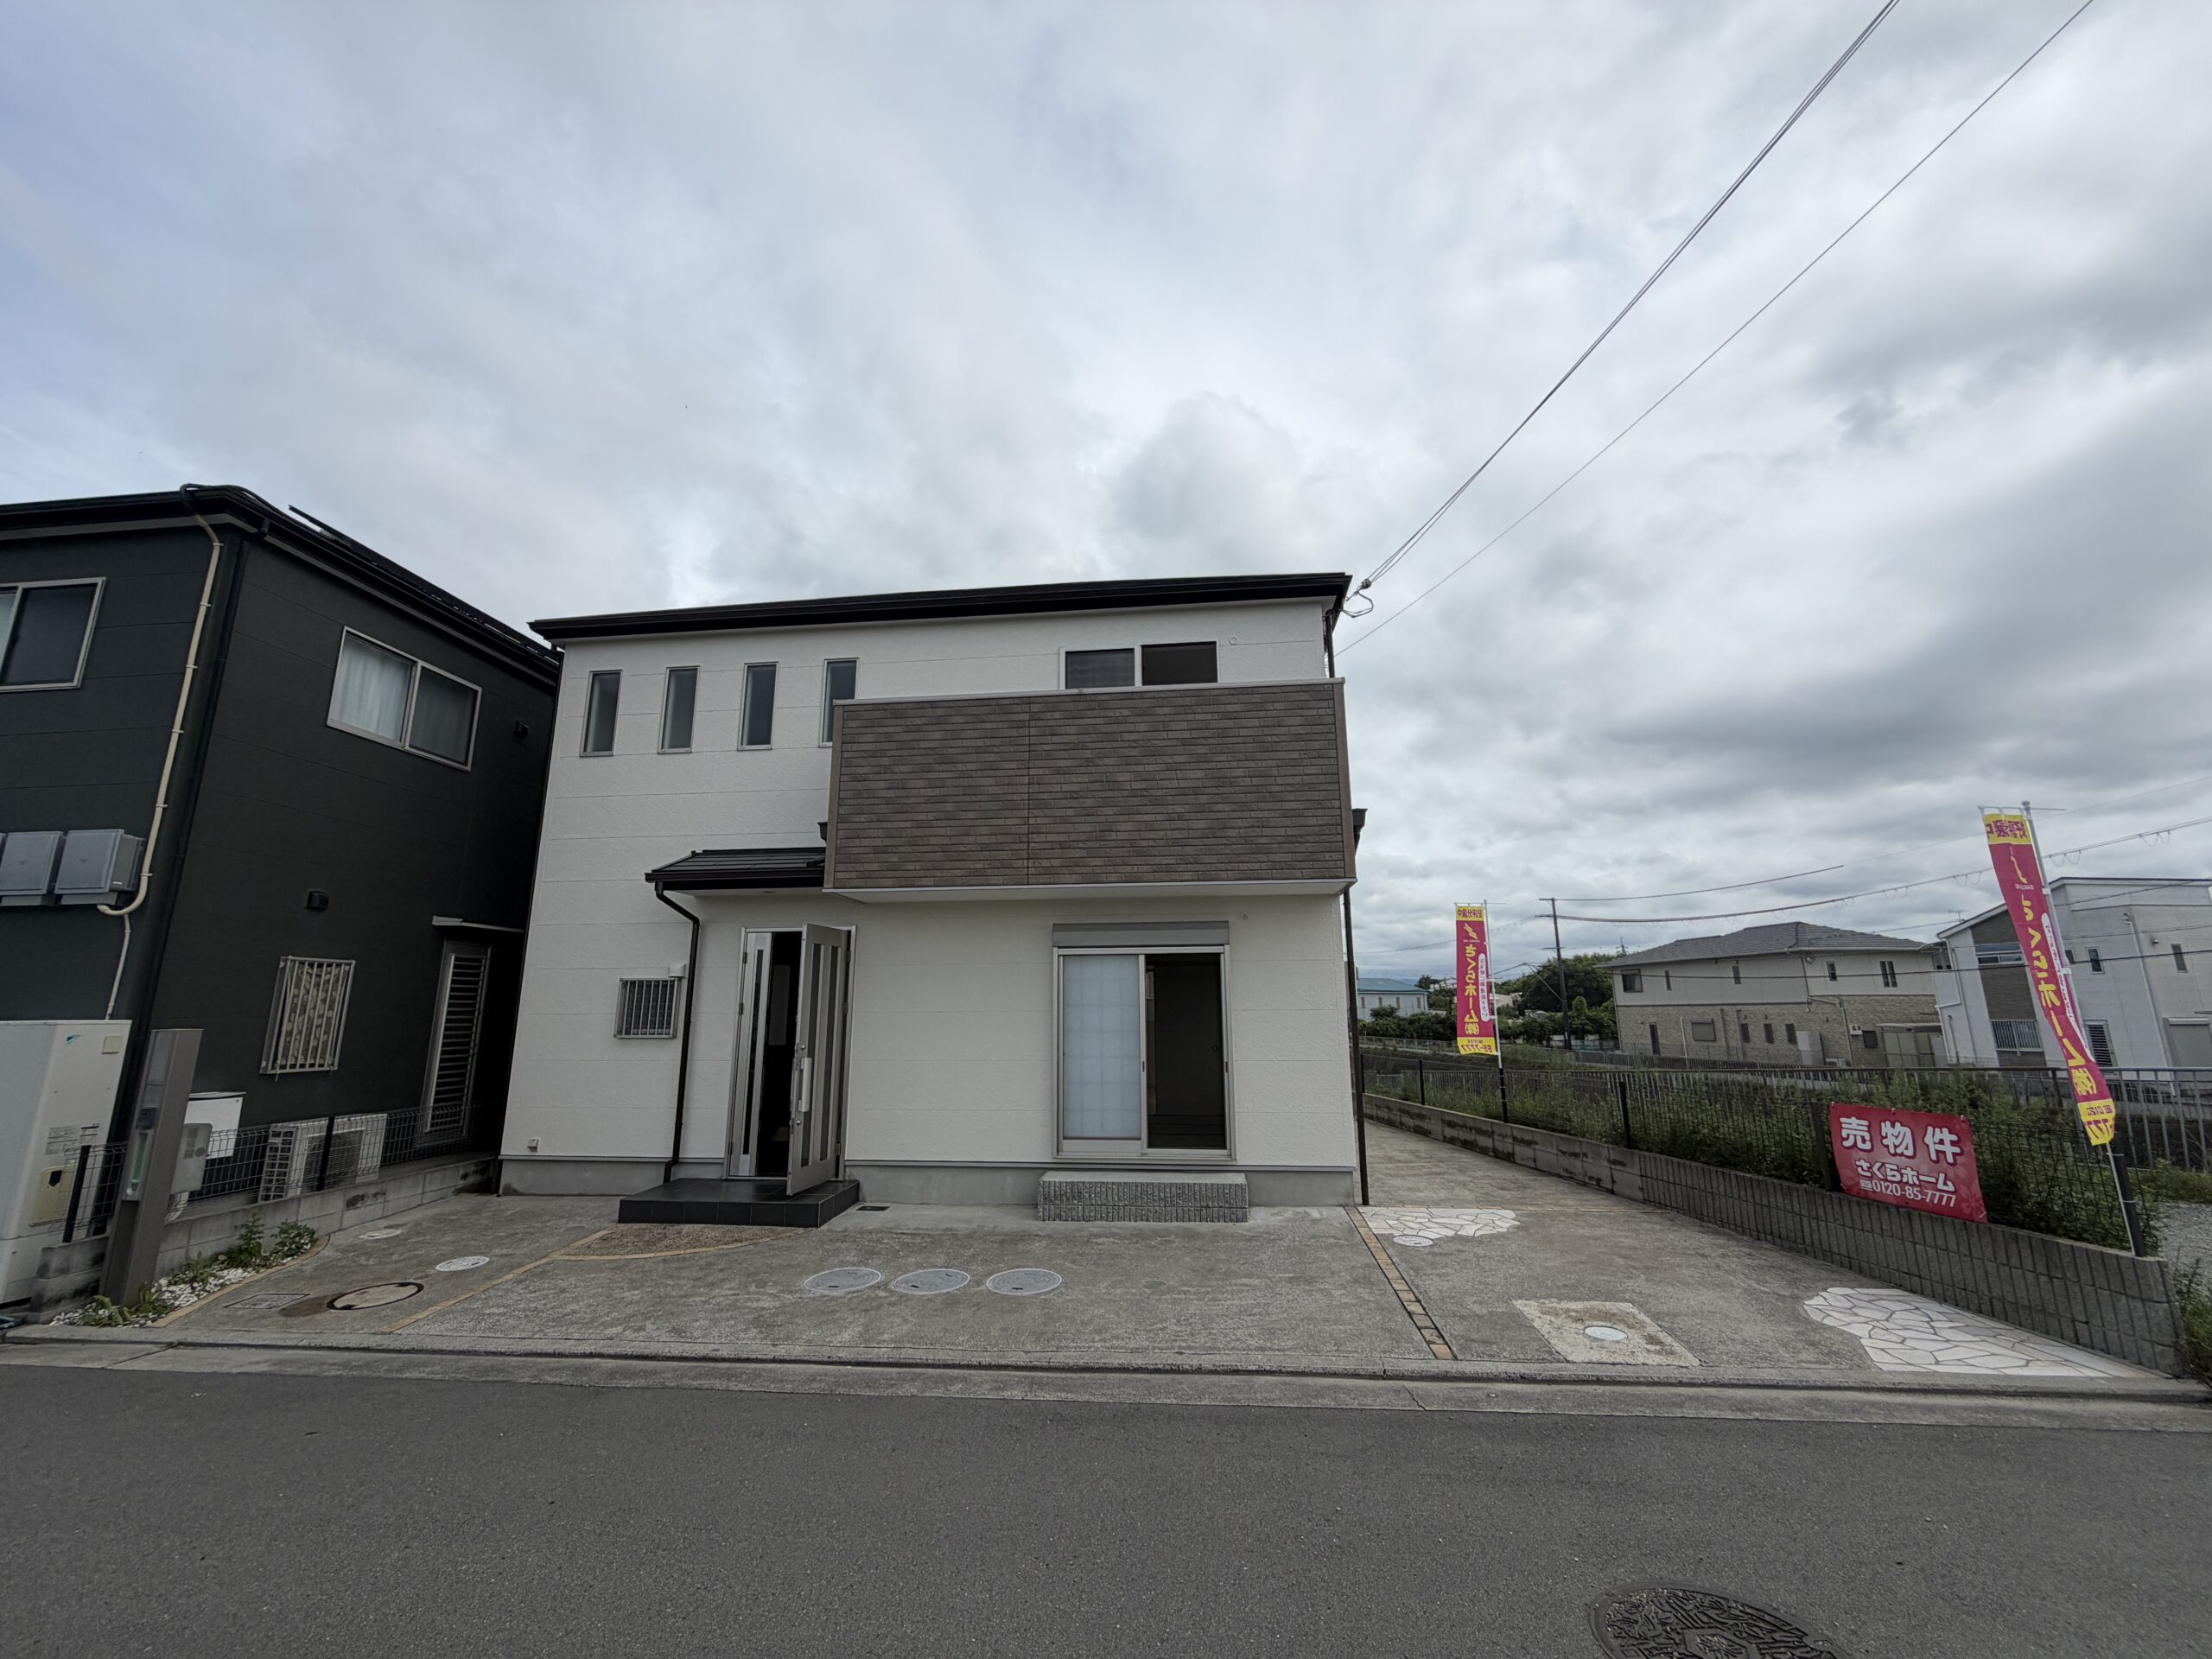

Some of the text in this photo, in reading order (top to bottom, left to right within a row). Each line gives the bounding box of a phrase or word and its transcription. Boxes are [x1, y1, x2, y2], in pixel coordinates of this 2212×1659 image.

[1839, 1116, 1961, 1164] 売物件
[1854, 1159, 1955, 1192] さくらホーム
[1872, 1179, 1956, 1207] 0120-85-7777
